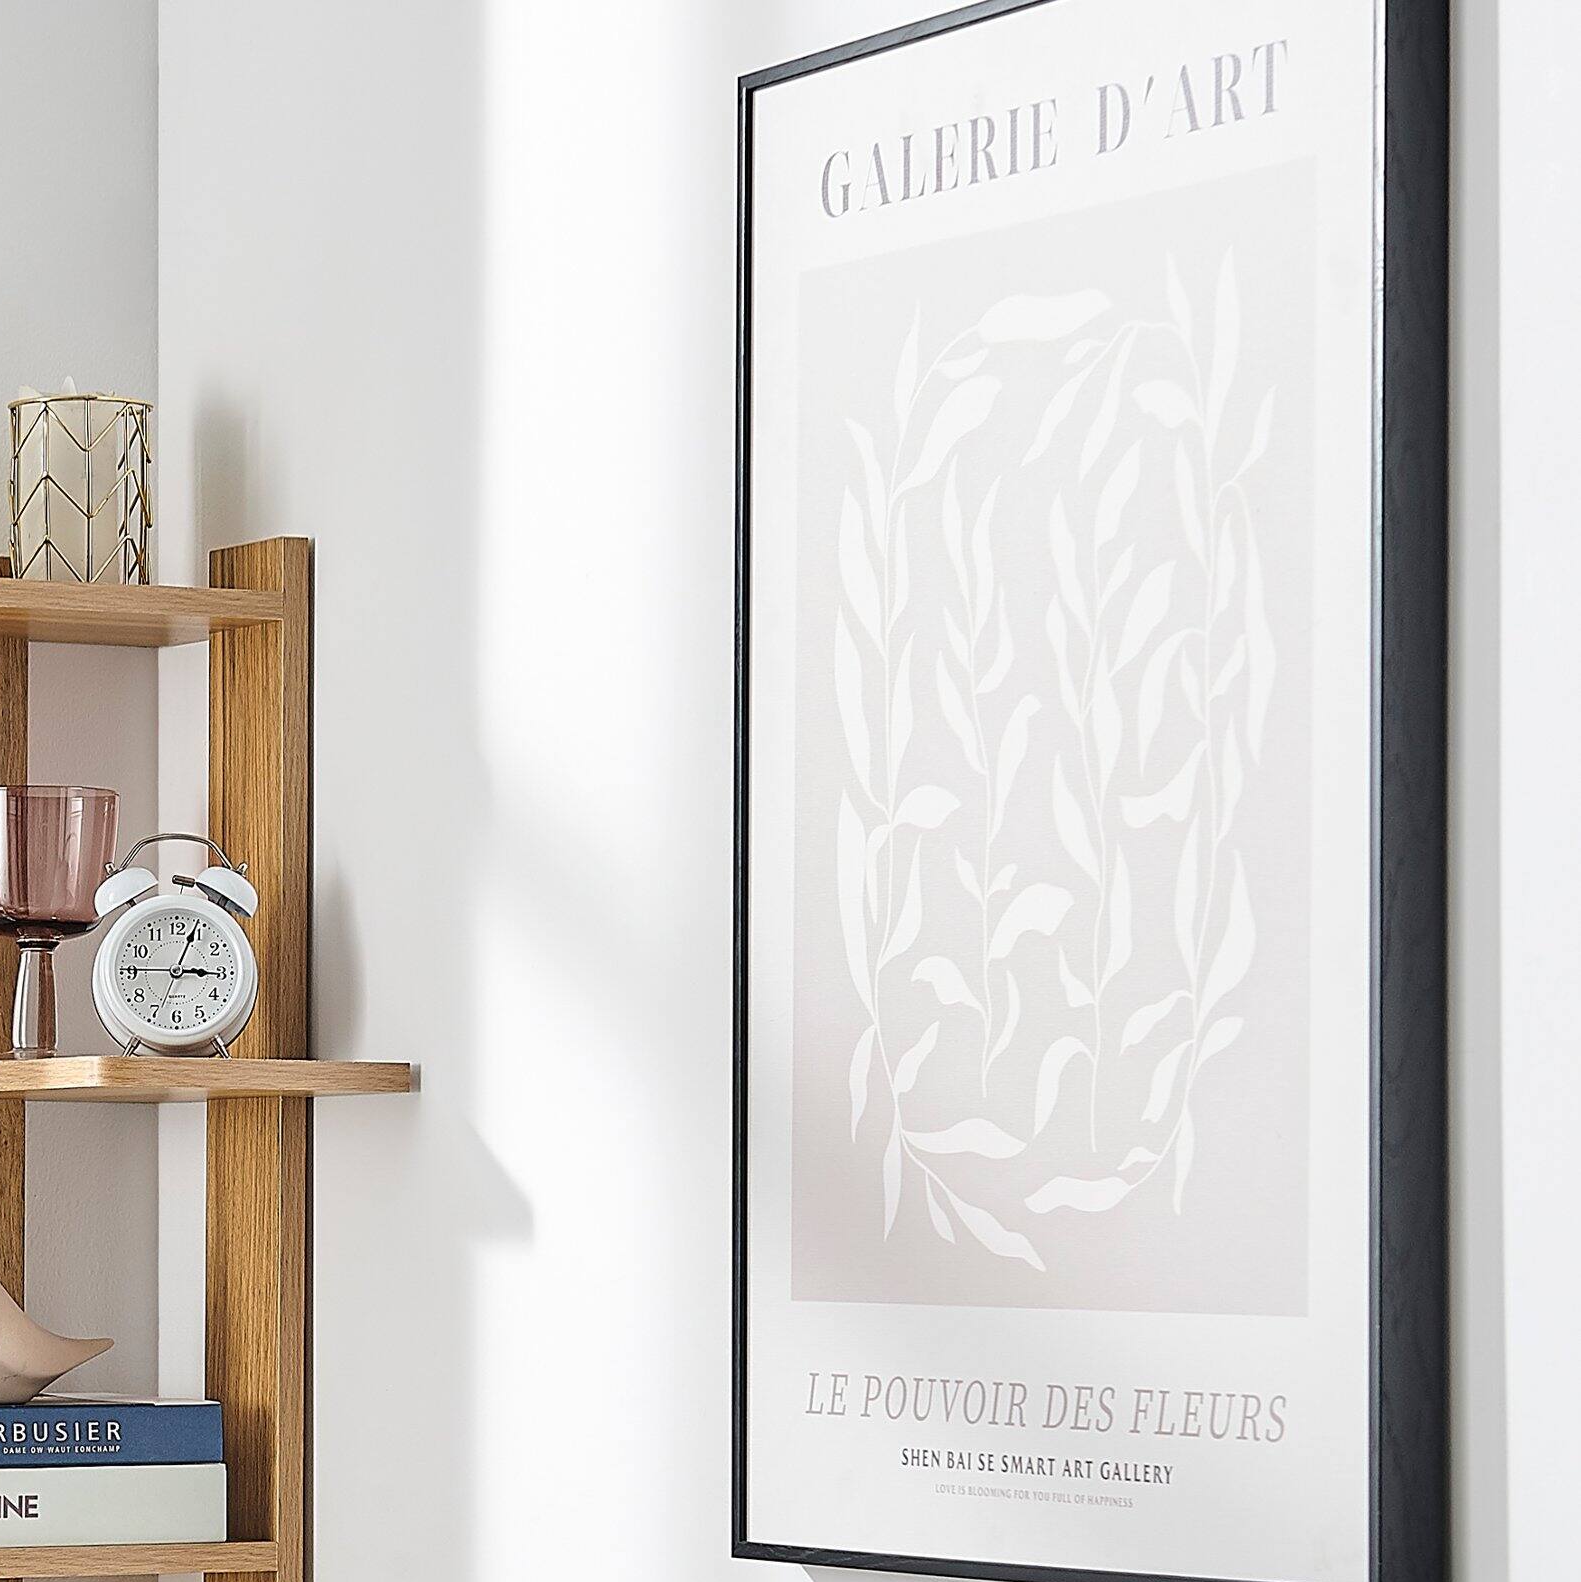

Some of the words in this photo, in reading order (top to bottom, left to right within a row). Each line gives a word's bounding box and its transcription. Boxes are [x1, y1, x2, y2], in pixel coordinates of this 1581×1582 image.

[821, 98, 1058, 219] GALERIE
[1095, 39, 1288, 156] D'ART
[149, 928, 162, 941] 11
[169, 922, 187, 935] 12
[196, 928, 203, 941] 1
[133, 945, 148, 958] 10
[209, 942, 220, 956] 2
[127, 965, 138, 980] 9
[216, 966, 227, 980] 3
[133, 988, 145, 1002] 8
[208, 987, 219, 1000] 4
[149, 1004, 160, 1018] 7
[171, 1010, 182, 1023] 6
[194, 1005, 205, 1019] 5
[805, 1371, 849, 1417] LE
[860, 1374, 1028, 1428] POUVOIR
[1042, 1383, 1117, 1432] DES
[1129, 1388, 1287, 1443] FLEURS
[3, 1446, 26, 1454] DAME
[901, 1448, 940, 1467] SHEN
[946, 1451, 971, 1470] BAI
[978, 1453, 995, 1472] SE
[1001, 1454, 1055, 1476] SMART
[1062, 1459, 1093, 1479] ART
[1100, 1461, 1173, 1485] GALLERY
[935, 1483, 956, 1495] LOVE
[958, 1485, 966, 1495] IS
[968, 1485, 1012, 1499] BLOOMING
[1014, 1489, 1030, 1500] FOR
[1032, 1491, 1050, 1502] YOU
[1052, 1492, 1072, 1504] FULL
[1074, 1494, 1085, 1505] OF
[1087, 1495, 1133, 1508] HAPPINESS
